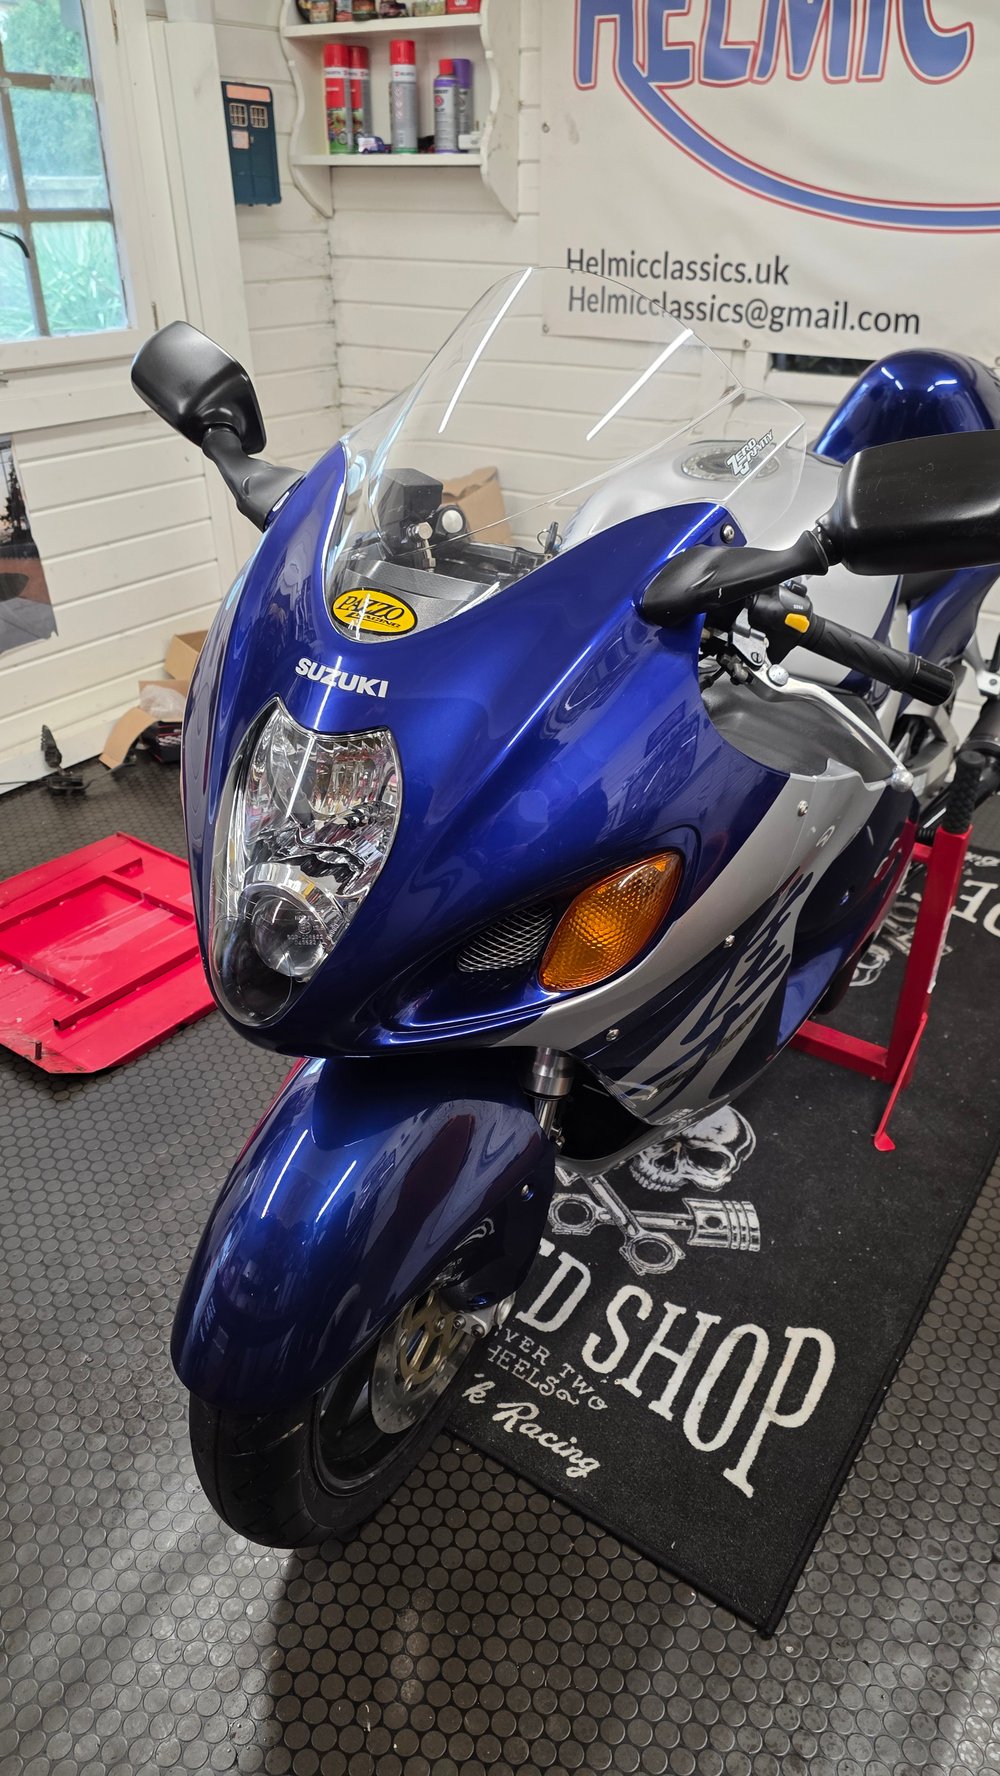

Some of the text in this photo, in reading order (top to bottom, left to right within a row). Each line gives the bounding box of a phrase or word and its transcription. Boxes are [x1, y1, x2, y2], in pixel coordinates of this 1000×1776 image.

[567, 248, 789, 286] Helmicclassics.uk
[569, 286, 921, 333] Helmicclassics@gmail.com
[336, 595, 405, 620] PAZZO
[294, 657, 389, 698] SUZUKI
[559, 1363, 608, 1410] TWO
[582, 1284, 836, 1499] SHOP
[492, 1402, 600, 1478] Racing
